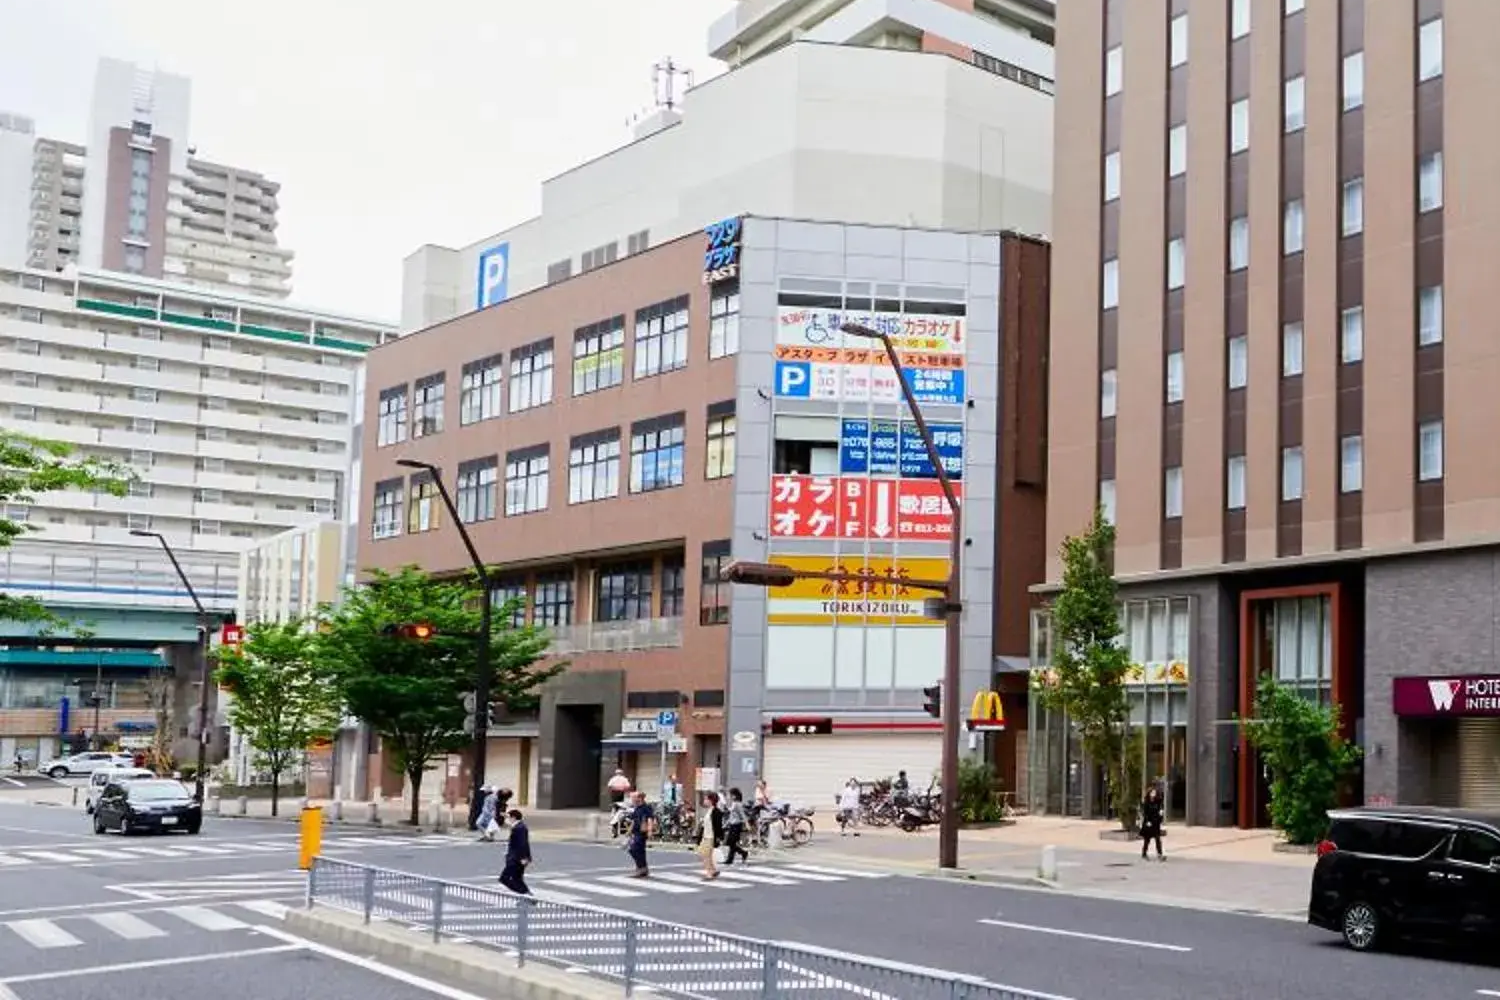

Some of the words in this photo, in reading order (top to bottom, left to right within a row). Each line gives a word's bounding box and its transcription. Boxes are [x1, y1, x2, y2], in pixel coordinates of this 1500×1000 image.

[483, 254, 504, 306] P
[702, 263, 737, 284] EAST
[903, 317, 952, 337] カラオケ
[780, 366, 806, 396] P
